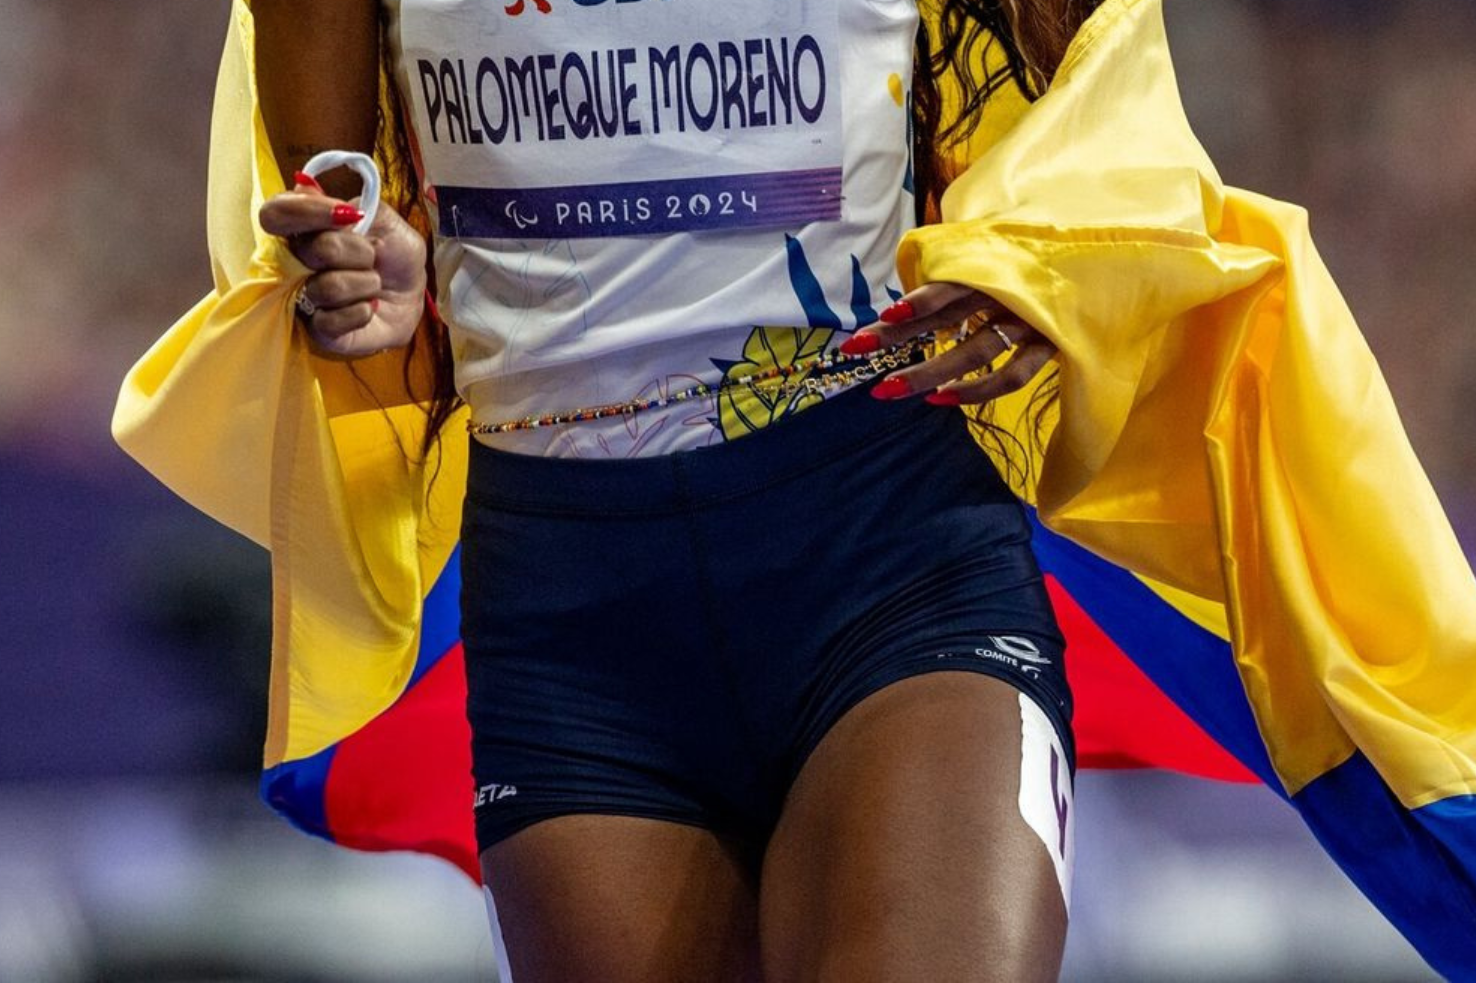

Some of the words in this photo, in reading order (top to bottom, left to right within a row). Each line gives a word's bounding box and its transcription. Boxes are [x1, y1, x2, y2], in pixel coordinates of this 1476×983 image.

[417, 48, 642, 145] PALOMEQUE
[648, 34, 825, 134] MORENO
[556, 197, 650, 224] PARIS
[666, 191, 758, 218] 2024
[473, 784, 517, 807] ETA
